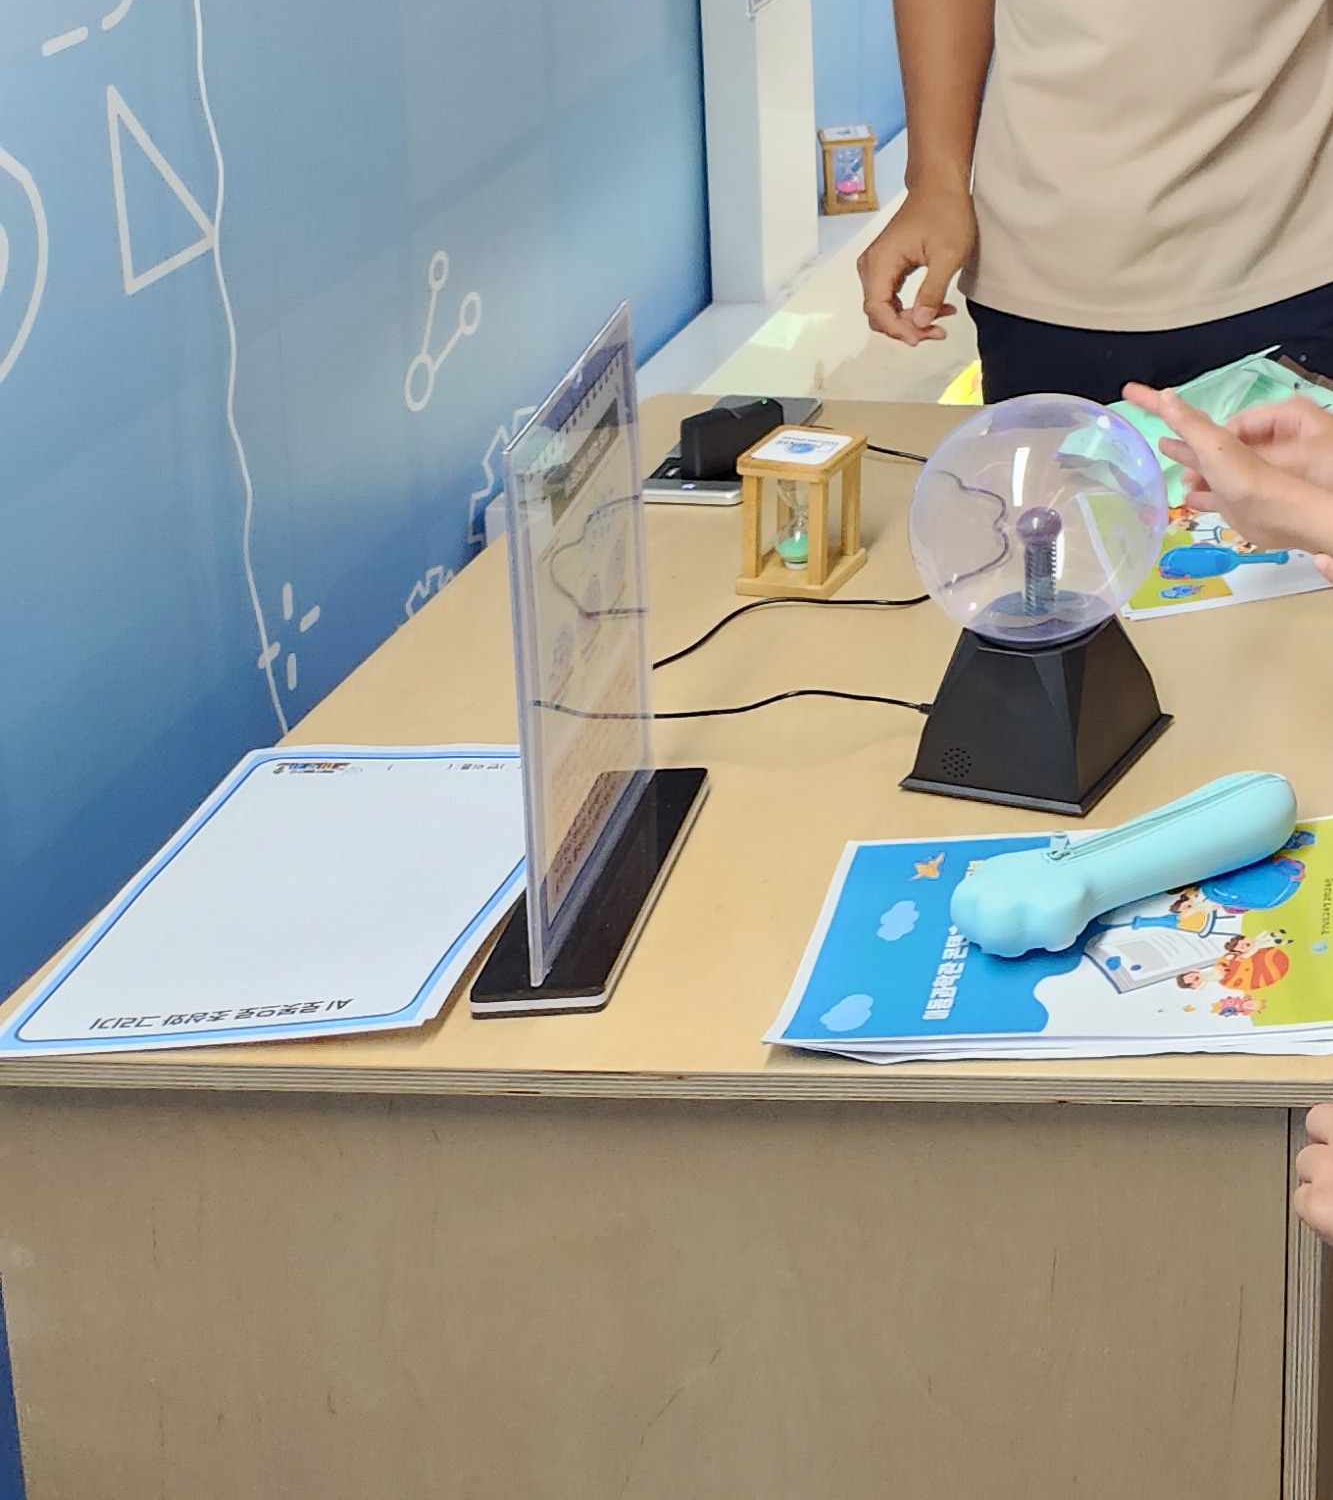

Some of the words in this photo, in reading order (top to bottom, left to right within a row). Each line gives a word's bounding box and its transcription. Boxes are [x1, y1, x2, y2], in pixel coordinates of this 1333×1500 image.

[941, 925, 969, 960] 콘텐
[234, 1000, 325, 1020] 로봇으로
[325, 998, 354, 1012] AI
[88, 1015, 161, 1031] 그리기
[163, 1009, 234, 1026] 초상화
